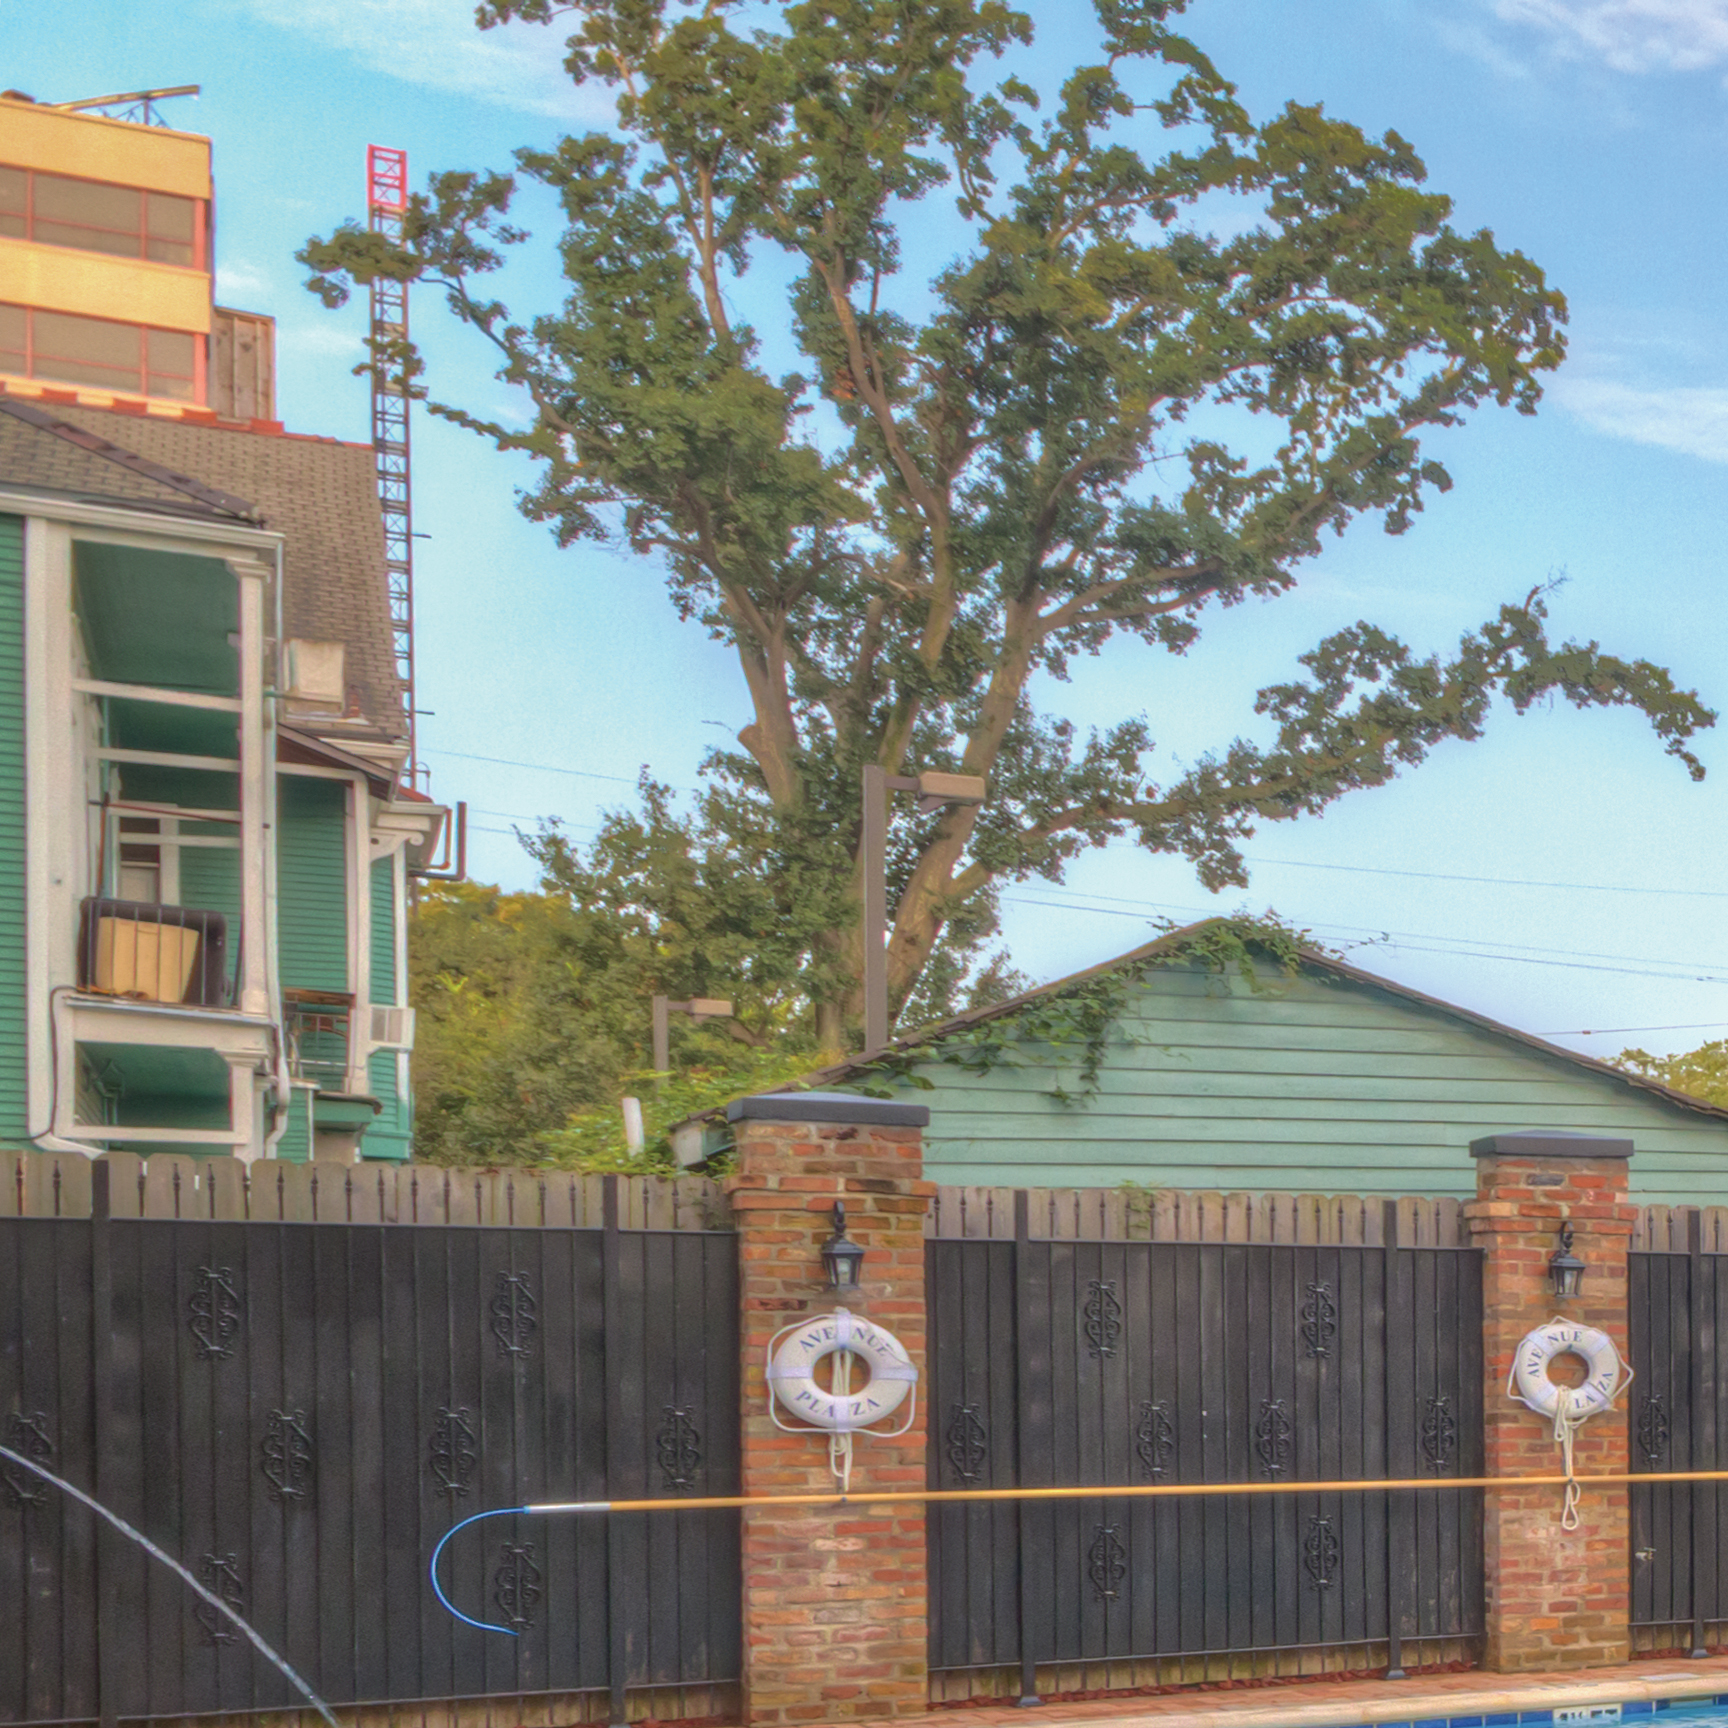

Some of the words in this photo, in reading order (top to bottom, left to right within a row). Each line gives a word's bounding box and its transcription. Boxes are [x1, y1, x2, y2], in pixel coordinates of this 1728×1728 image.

[798, 1325, 895, 1358] AVENUE
[1527, 1330, 1583, 1378] AVENUE
[794, 1391, 882, 1418] PLAZA
[1574, 1371, 1614, 1409] LAZA
